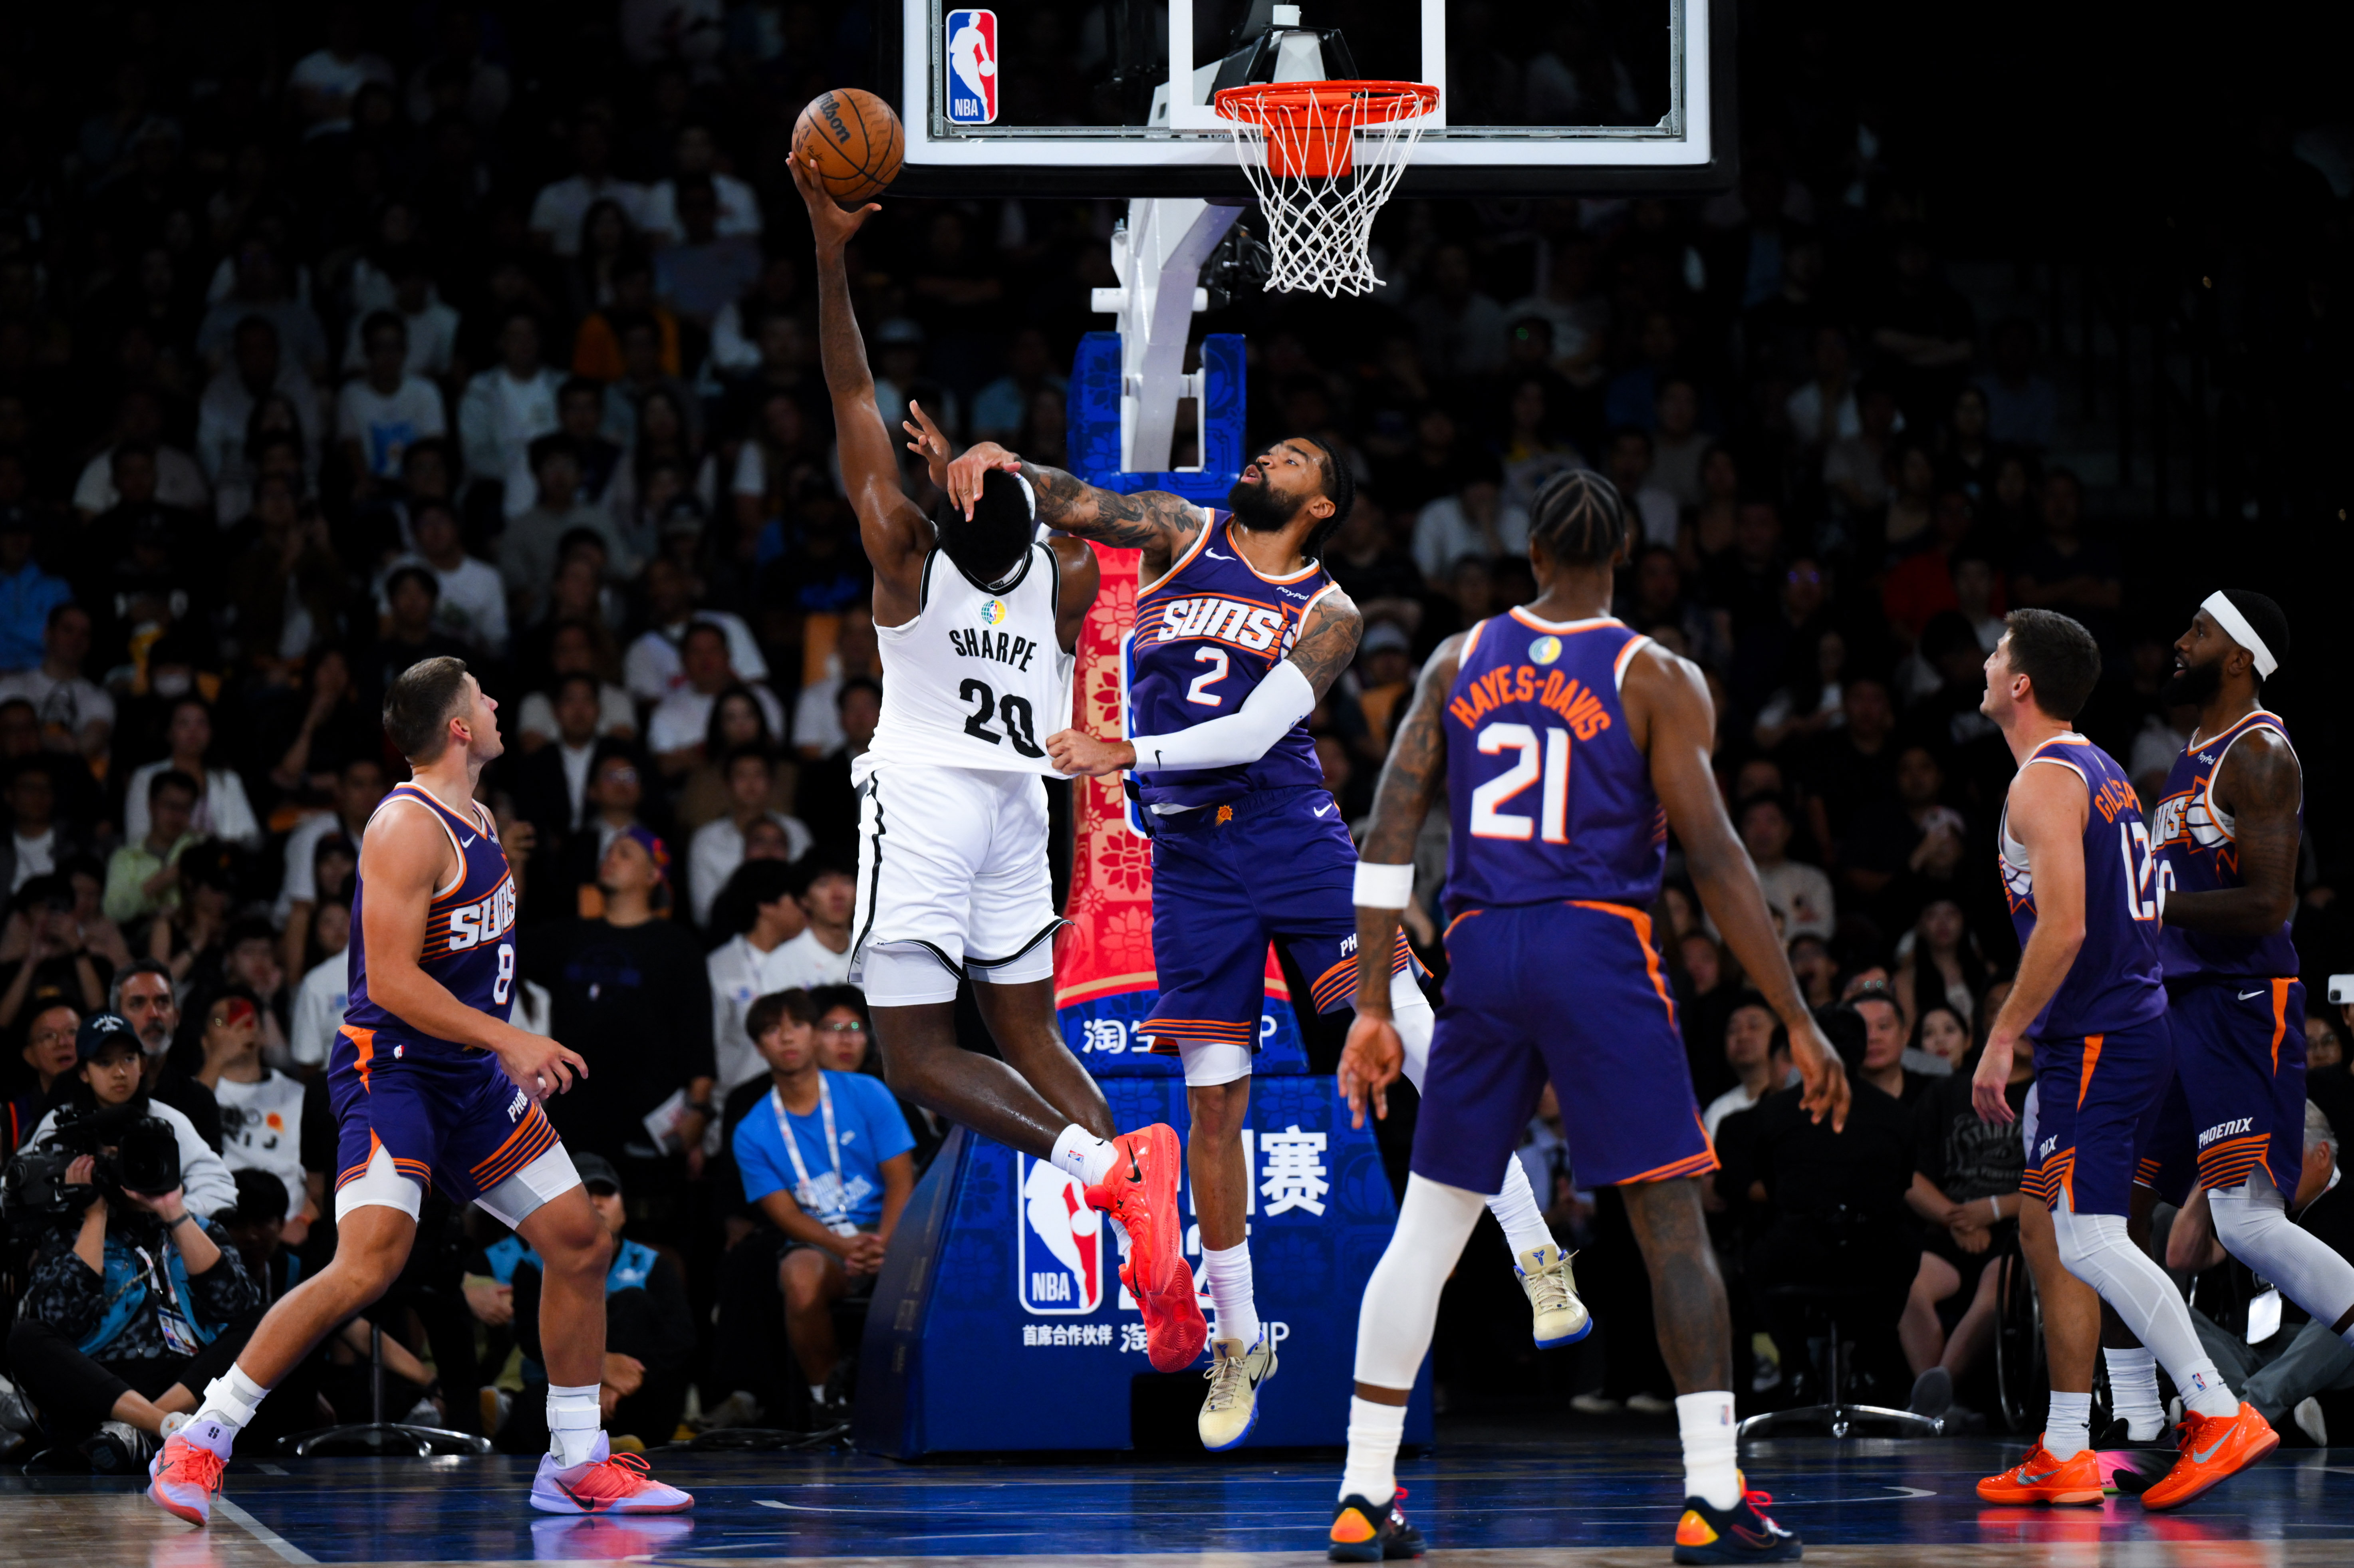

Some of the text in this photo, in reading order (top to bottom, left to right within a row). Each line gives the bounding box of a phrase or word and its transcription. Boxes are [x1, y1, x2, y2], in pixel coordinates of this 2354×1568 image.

[814, 91, 851, 145] Wilson
[955, 99, 979, 116] NBA
[1276, 586, 1310, 600] PayPal
[949, 628, 1037, 673] SHARPE
[1157, 598, 1283, 651] SUNS
[1187, 646, 1230, 707] 2
[1449, 665, 1612, 741] HAYES-DAVIS
[959, 678, 1046, 758] 20
[1470, 722, 1570, 844] 21
[2197, 751, 2216, 765] PayPal
[2150, 796, 2186, 852] UNS
[2120, 822, 2156, 921] 12
[449, 872, 516, 951] SUNS
[493, 944, 514, 1005] 8
[2199, 1117, 2253, 1149] PHOENIX
[1032, 1272, 1071, 1302] NBA
[1022, 1324, 1113, 1346] 首席合作伙伴
